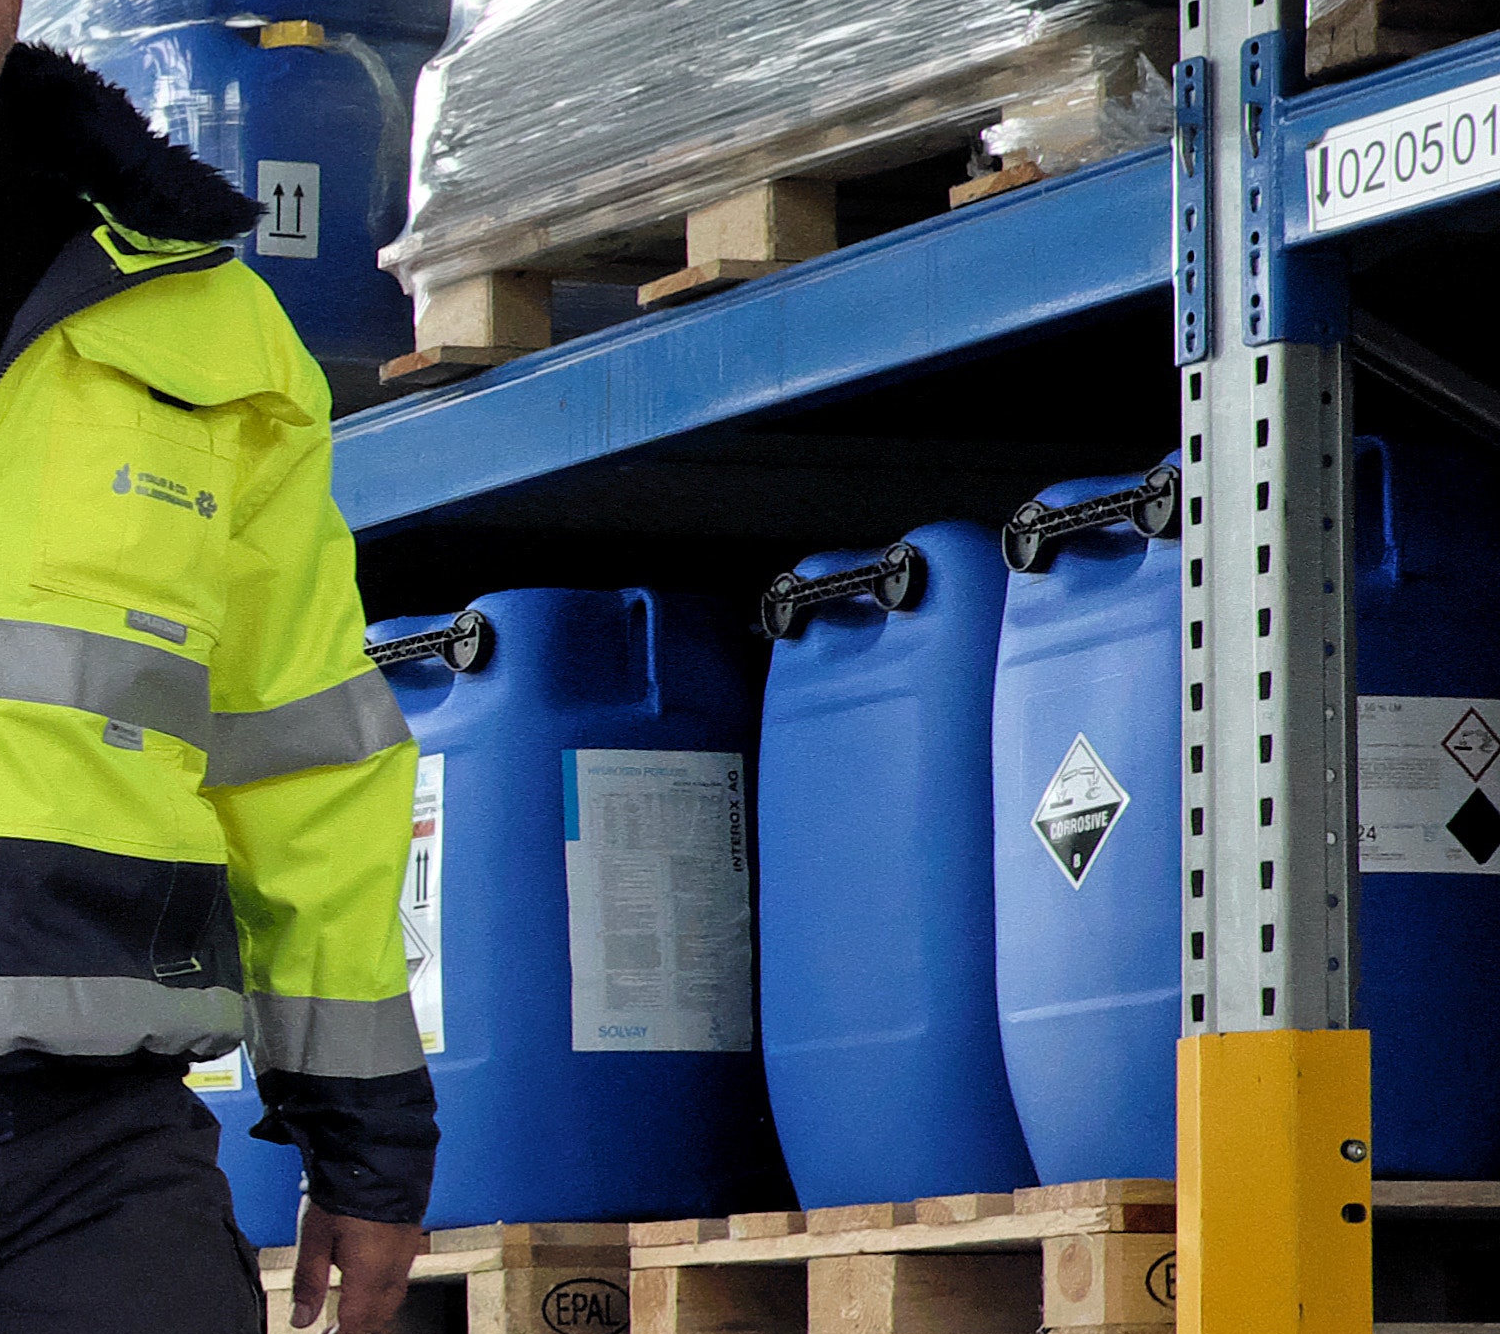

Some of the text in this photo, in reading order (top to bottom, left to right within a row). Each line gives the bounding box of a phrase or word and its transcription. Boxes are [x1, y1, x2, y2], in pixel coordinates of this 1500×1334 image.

[727, 770, 744, 873] INTEROX AG
[1050, 810, 1110, 841] CORROSIVE
[1072, 853, 1082, 868] 8
[598, 1025, 648, 1039] SOLVAY
[556, 1292, 622, 1326] EPAL
